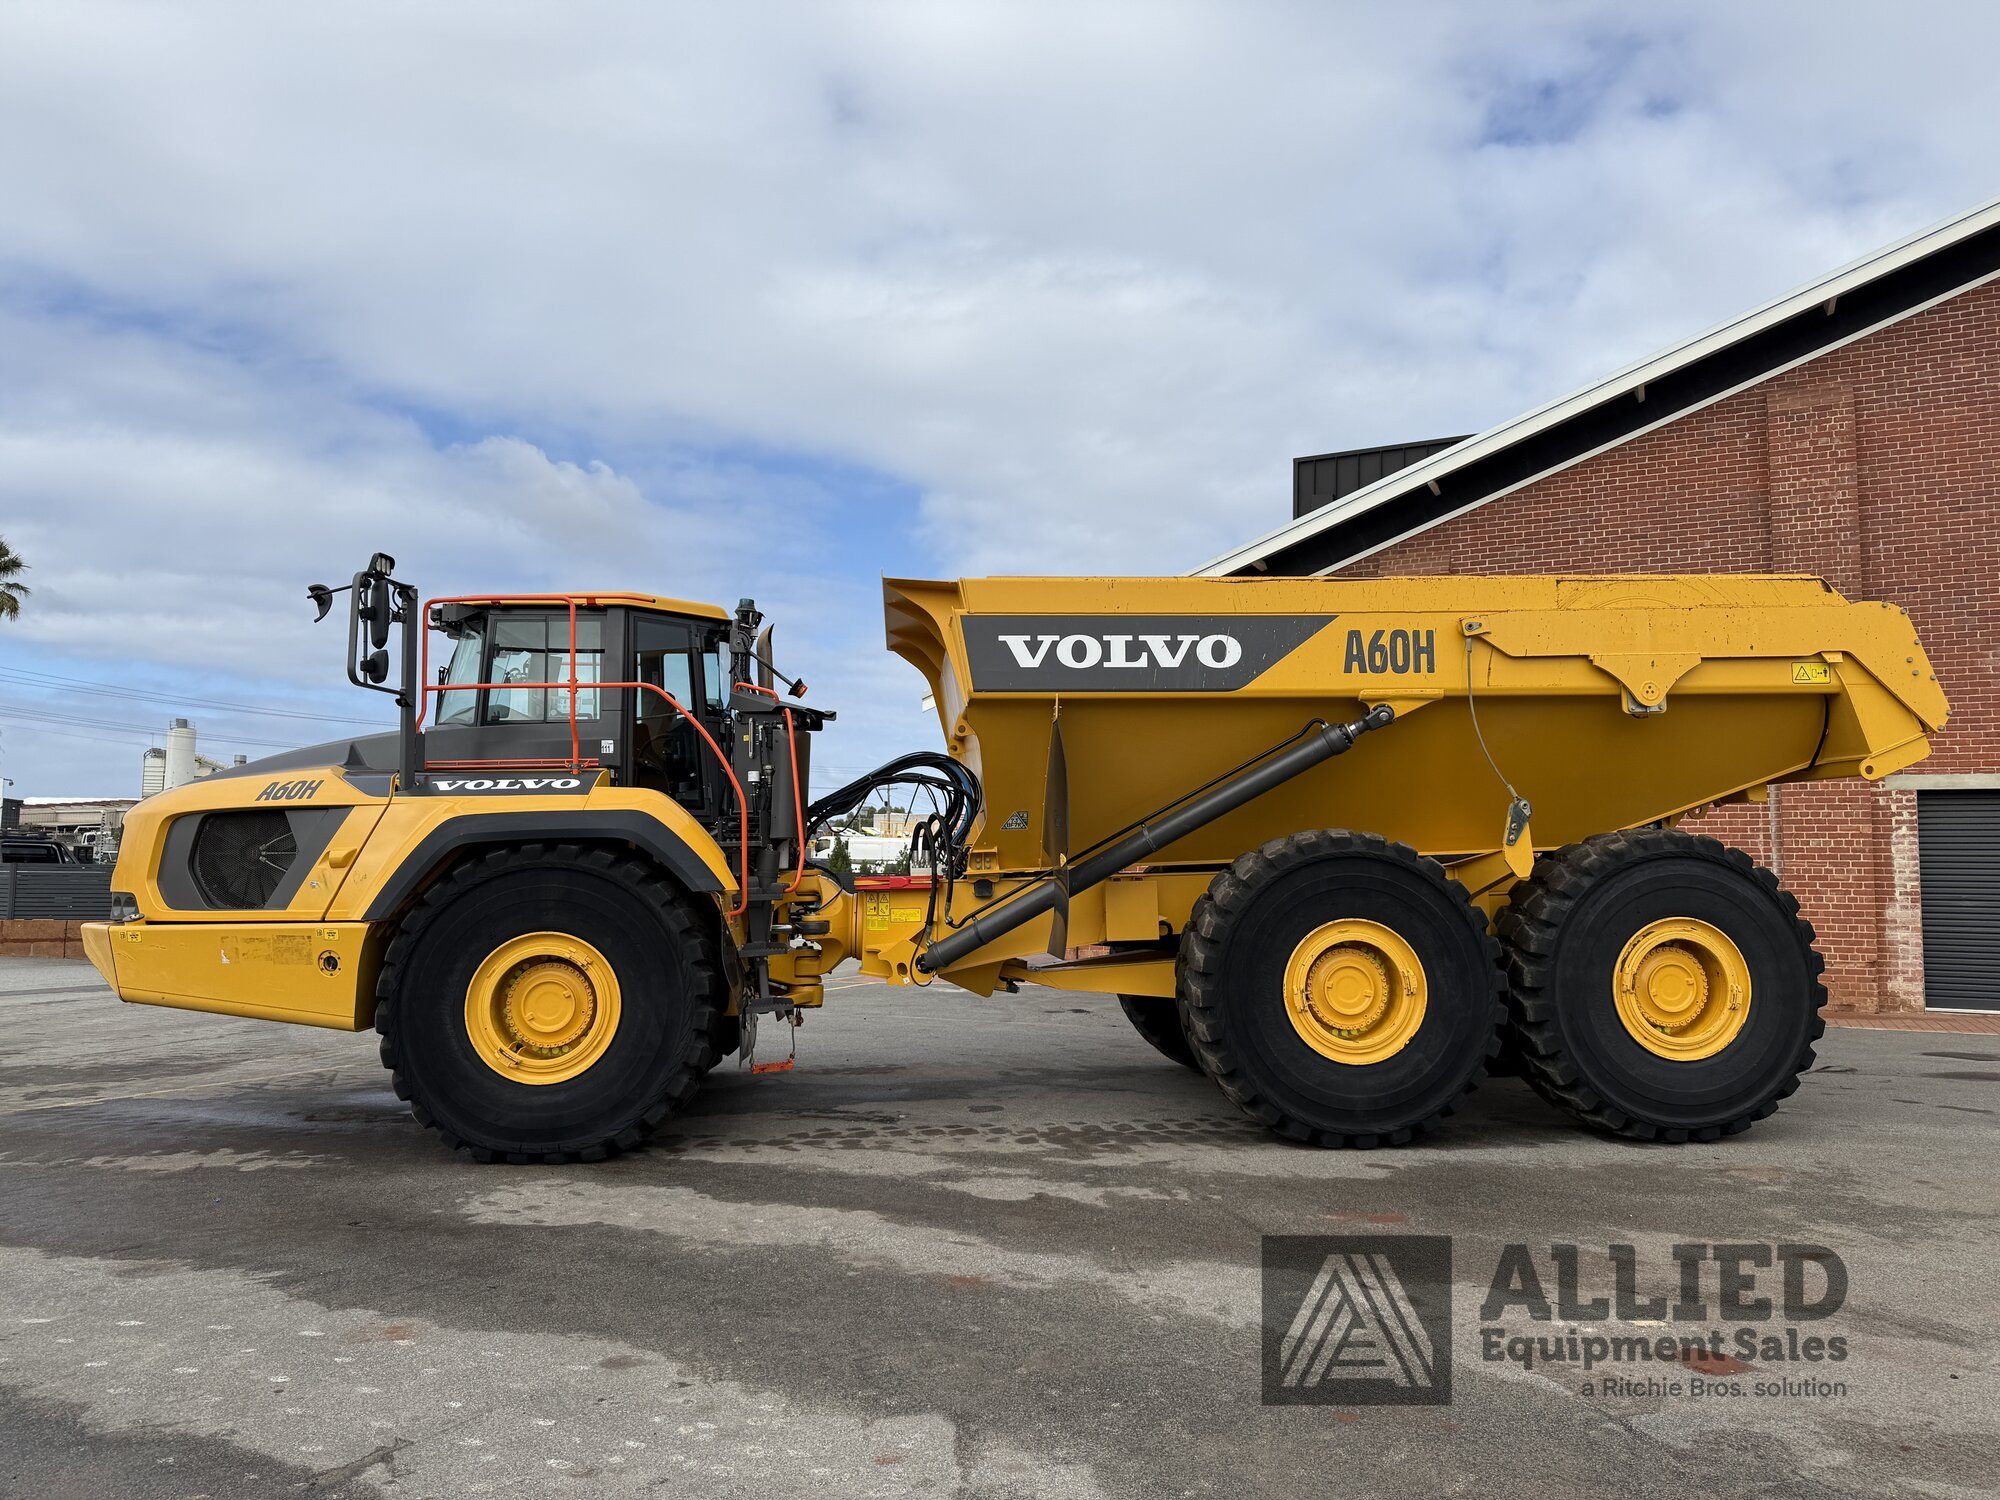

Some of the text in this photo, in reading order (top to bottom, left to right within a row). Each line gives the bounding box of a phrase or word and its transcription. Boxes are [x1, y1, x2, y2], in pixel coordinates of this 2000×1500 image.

[998, 633, 1242, 670] VOLVO
[1343, 629, 1436, 675] A60H
[254, 779, 325, 802] A60H
[432, 778, 581, 791] VOLVO
